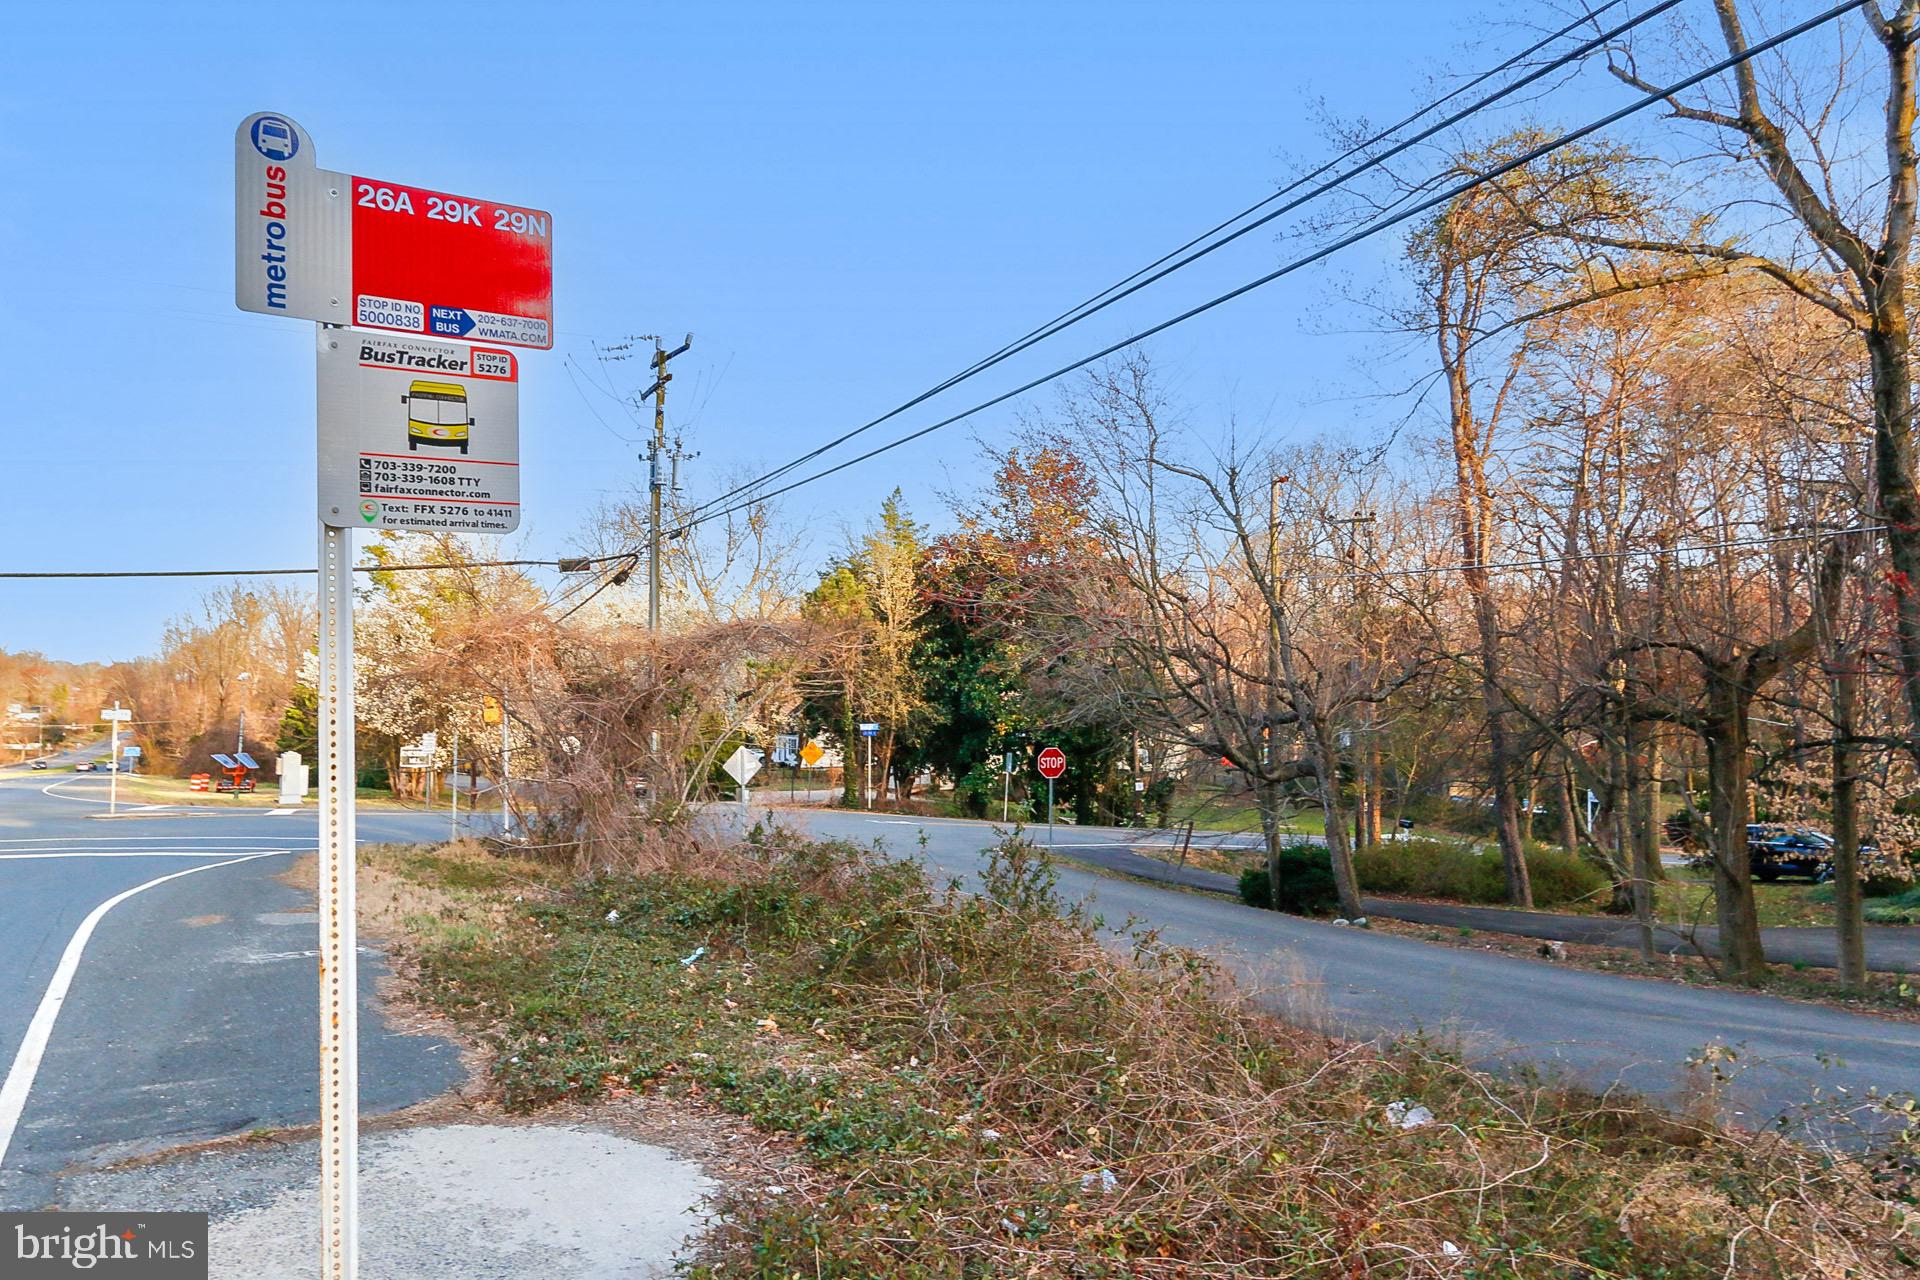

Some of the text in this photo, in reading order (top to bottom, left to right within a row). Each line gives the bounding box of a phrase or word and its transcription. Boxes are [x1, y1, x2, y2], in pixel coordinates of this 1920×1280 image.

[357, 184, 546, 238] 26A 29K 29N
[260, 165, 287, 309] metrobus
[360, 297, 423, 316] STOP ID NO.
[359, 310, 420, 329] 5000838
[432, 308, 463, 321] NEXT
[436, 321, 460, 334] BUS
[478, 314, 546, 331] 202-637-7000
[478, 327, 547, 344] WMATA.COM
[362, 339, 455, 355] FAIRFAX CONNECTOR
[359, 346, 468, 371] BusTracker
[477, 353, 508, 363] STOP ID
[478, 364, 507, 374] 5276
[374, 460, 456, 475] 703-339-7200
[374, 472, 481, 487] 703-339-1608 TTY
[374, 483, 491, 499] fairfaxconnector.com
[381, 503, 512, 518] Text: FFX 5276 to 41411
[382, 516, 508, 529] for estimated arrival times.
[1040, 757, 1063, 768] STOP
